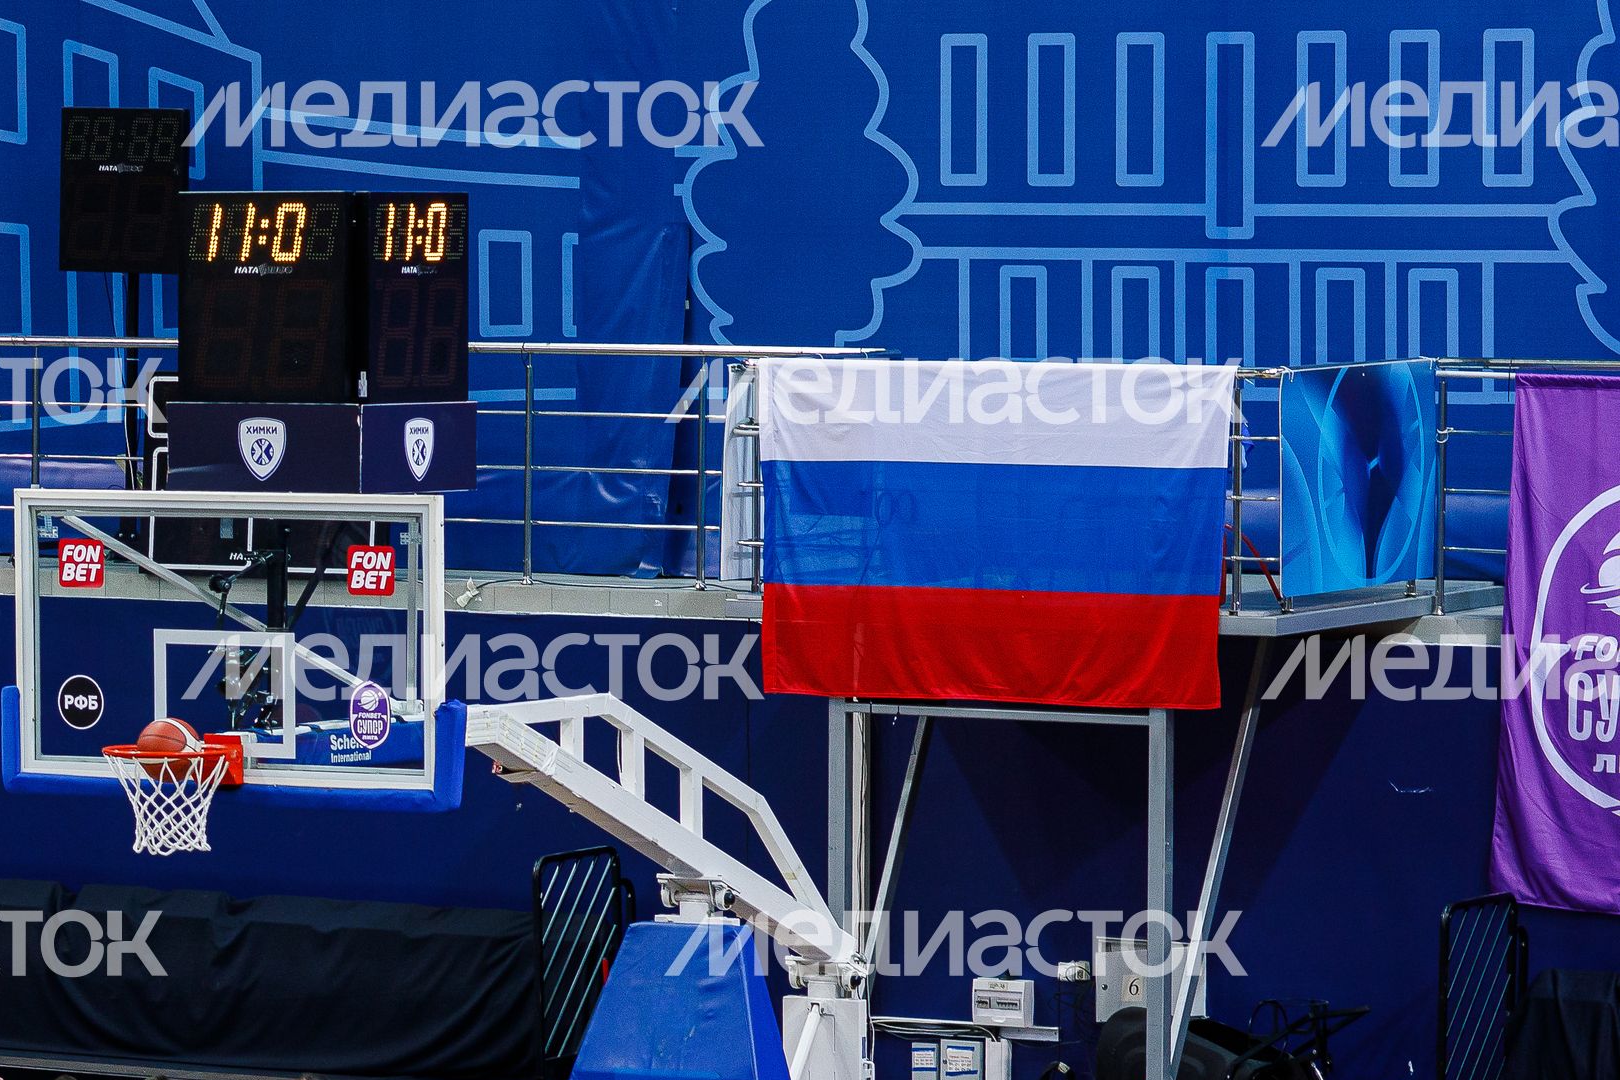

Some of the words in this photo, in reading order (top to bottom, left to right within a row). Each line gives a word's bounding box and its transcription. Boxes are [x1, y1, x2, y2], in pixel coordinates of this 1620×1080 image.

[245, 425, 278, 435] ХИМКИ
[409, 426, 429, 435] ХИМКИ
[61, 543, 101, 564] FON
[350, 551, 392, 570] FON
[61, 563, 100, 584] BET
[350, 570, 391, 590] BET
[63, 693, 99, 711] РФБ
[330, 750, 372, 763] International
[1128, 977, 1140, 997] 6
